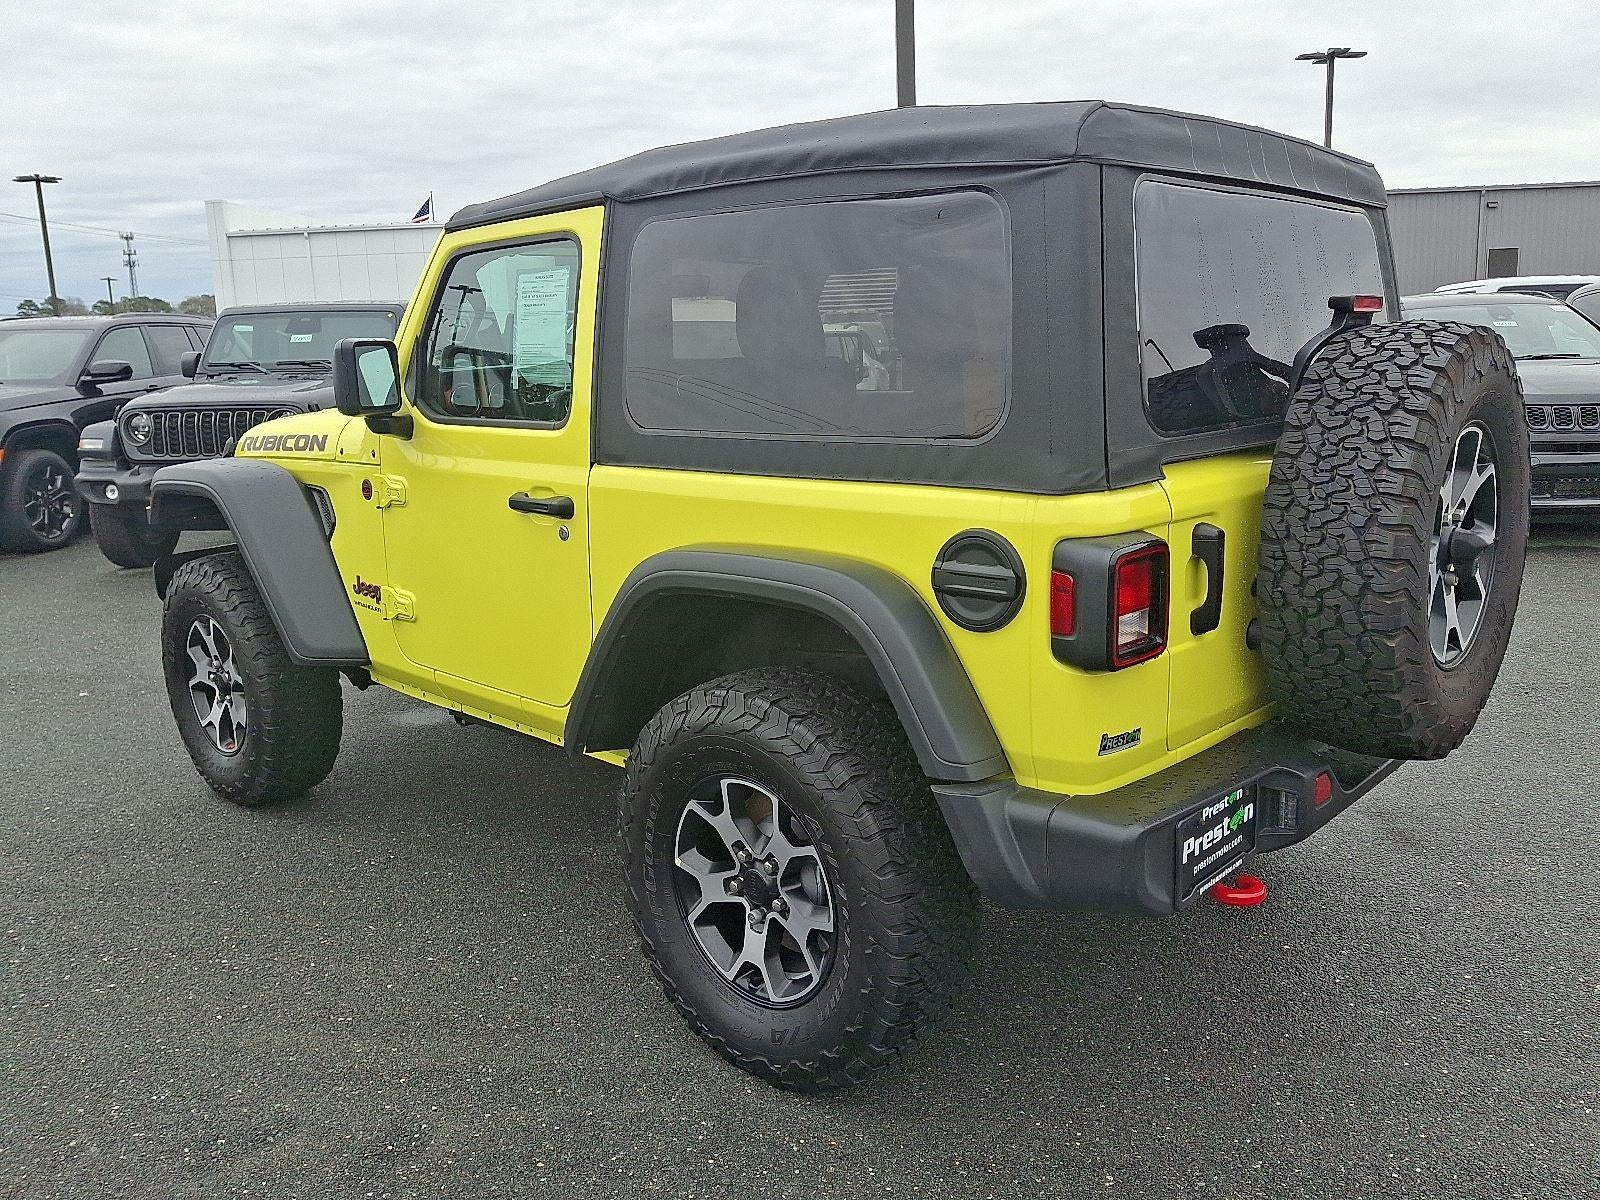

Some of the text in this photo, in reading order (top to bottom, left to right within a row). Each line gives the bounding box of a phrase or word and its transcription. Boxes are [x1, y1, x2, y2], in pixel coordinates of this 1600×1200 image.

[241, 434, 328, 452] RUBICON
[353, 575, 382, 604] Jeep
[1182, 802, 1254, 865] Preston
[1193, 834, 1243, 877] prestonmotor.com
